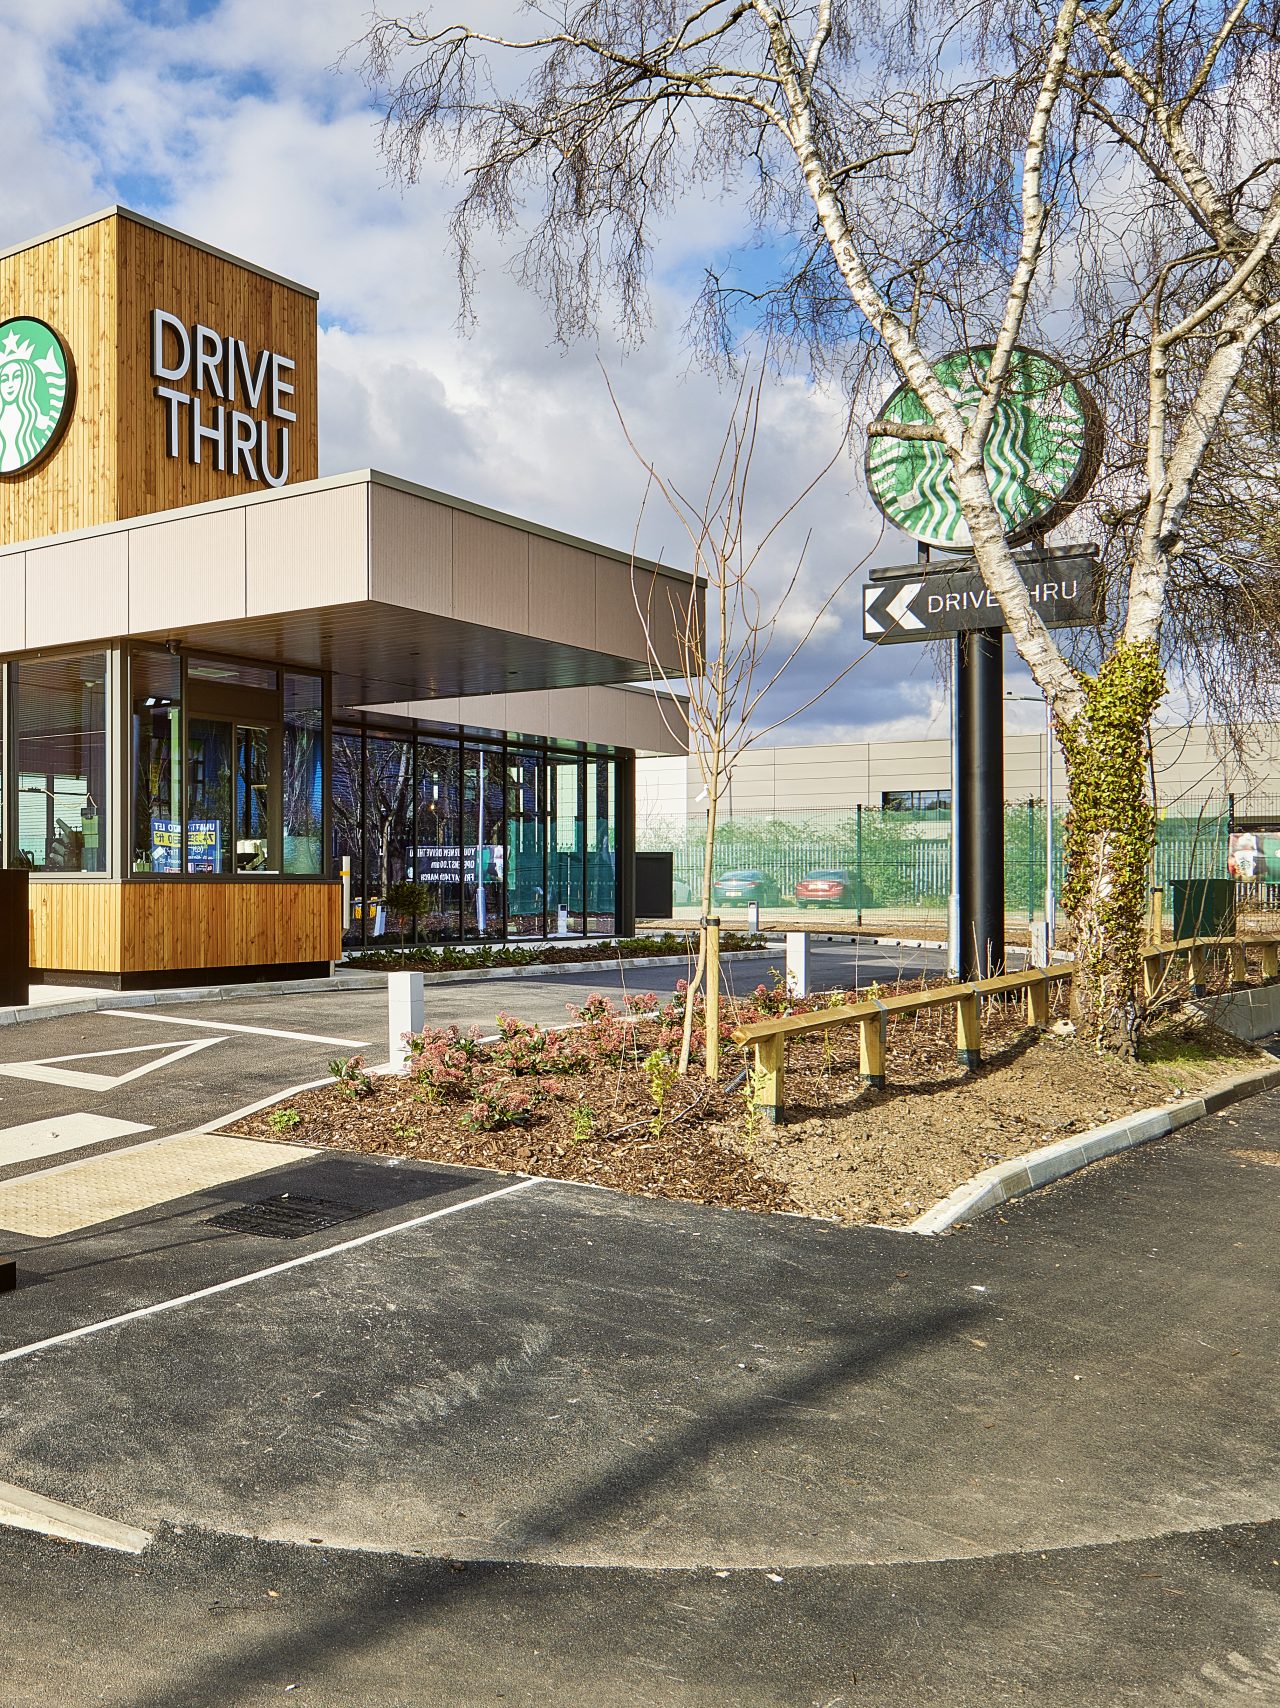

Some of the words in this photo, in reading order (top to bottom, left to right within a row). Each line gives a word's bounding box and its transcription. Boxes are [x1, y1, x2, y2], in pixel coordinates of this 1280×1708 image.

[151, 308, 297, 422] DRIVE
[154, 385, 289, 488] THRU
[927, 589, 1000, 613] DRIVE
[1025, 580, 1078, 603] HRU
